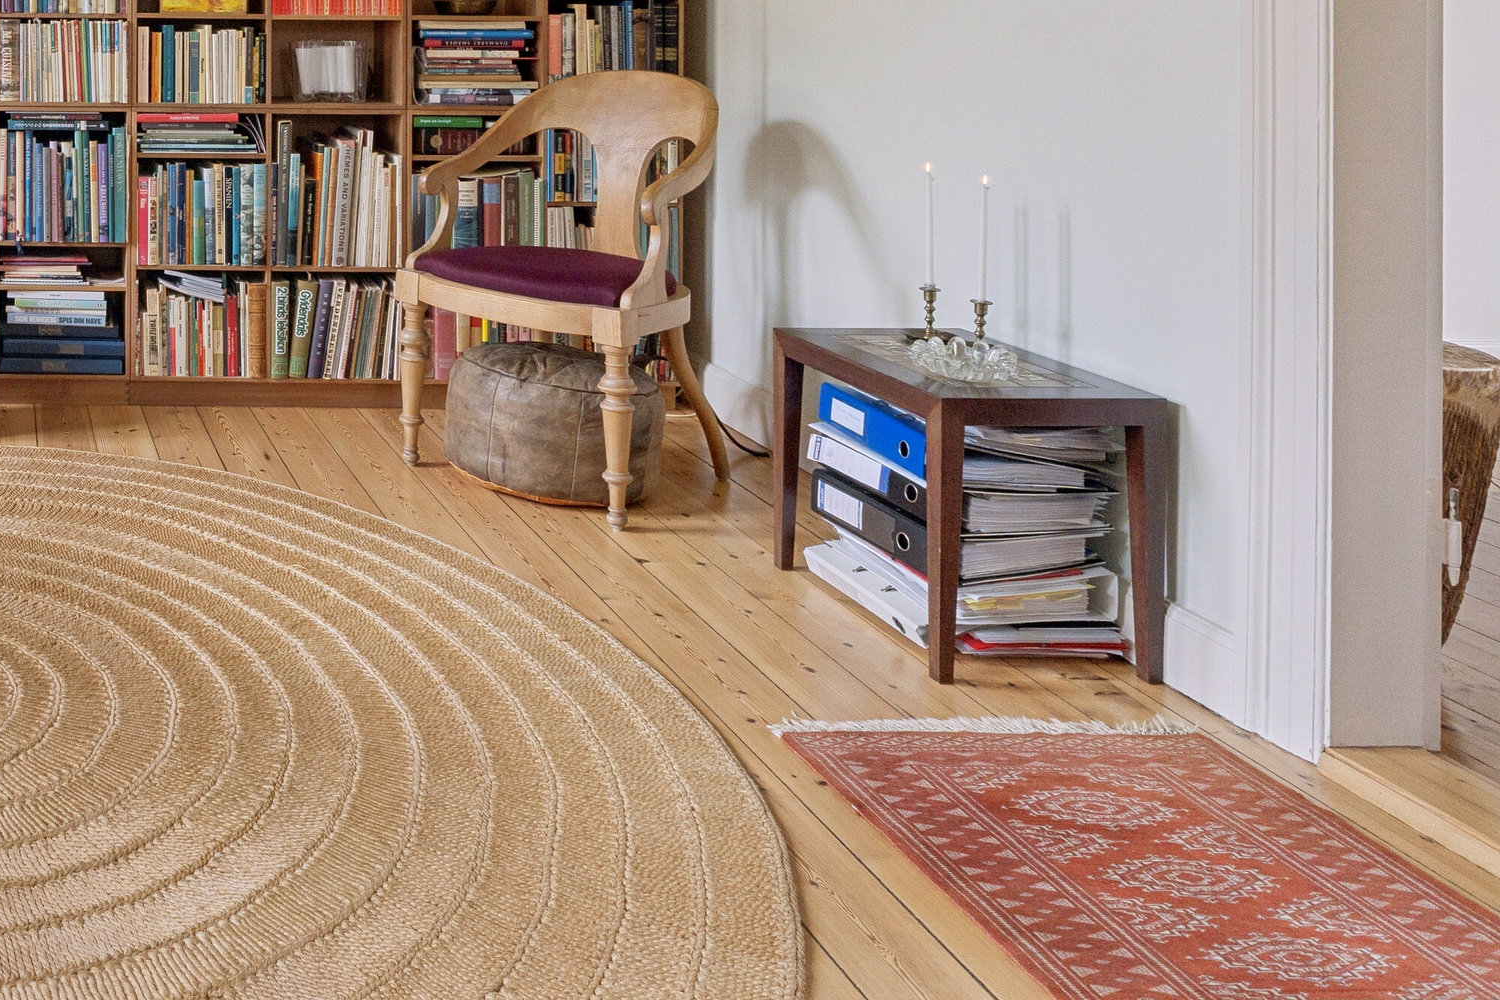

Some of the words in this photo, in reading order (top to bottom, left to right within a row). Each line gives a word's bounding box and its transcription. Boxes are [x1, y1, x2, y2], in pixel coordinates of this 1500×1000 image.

[2, 30, 12, 44] Ma
[1, 46, 12, 85] CUISINE
[225, 177, 233, 209] SPANIEN
[341, 182, 349, 200] AND
[338, 203, 348, 252] VARIATIONS
[85, 317, 102, 325] HAVE
[295, 290, 311, 336] Gyldendals
[316, 293, 328, 356] BRØNDUMS
[276, 320, 288, 354] leksikon
